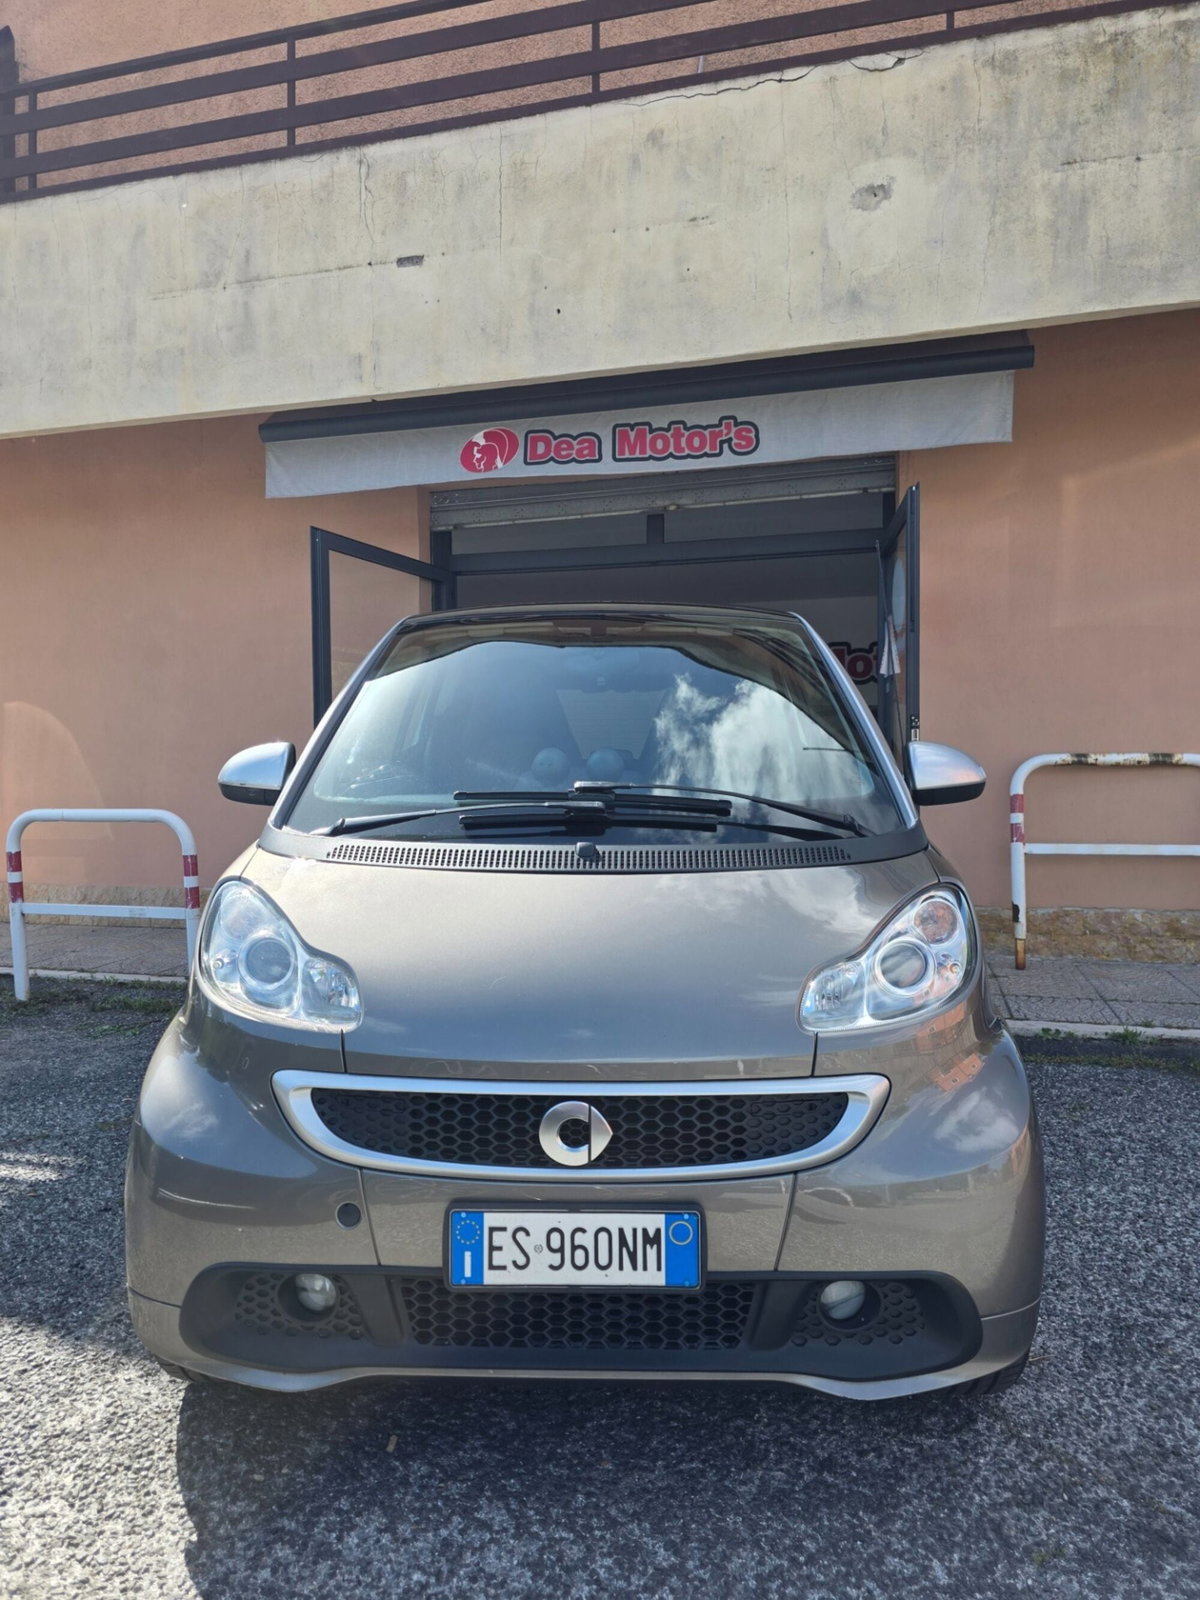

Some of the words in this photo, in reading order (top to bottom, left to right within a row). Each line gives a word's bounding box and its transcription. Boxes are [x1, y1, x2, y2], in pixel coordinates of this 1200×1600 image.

[524, 429, 601, 465] Dea
[613, 416, 759, 461] Motor's
[464, 1251, 471, 1277] I
